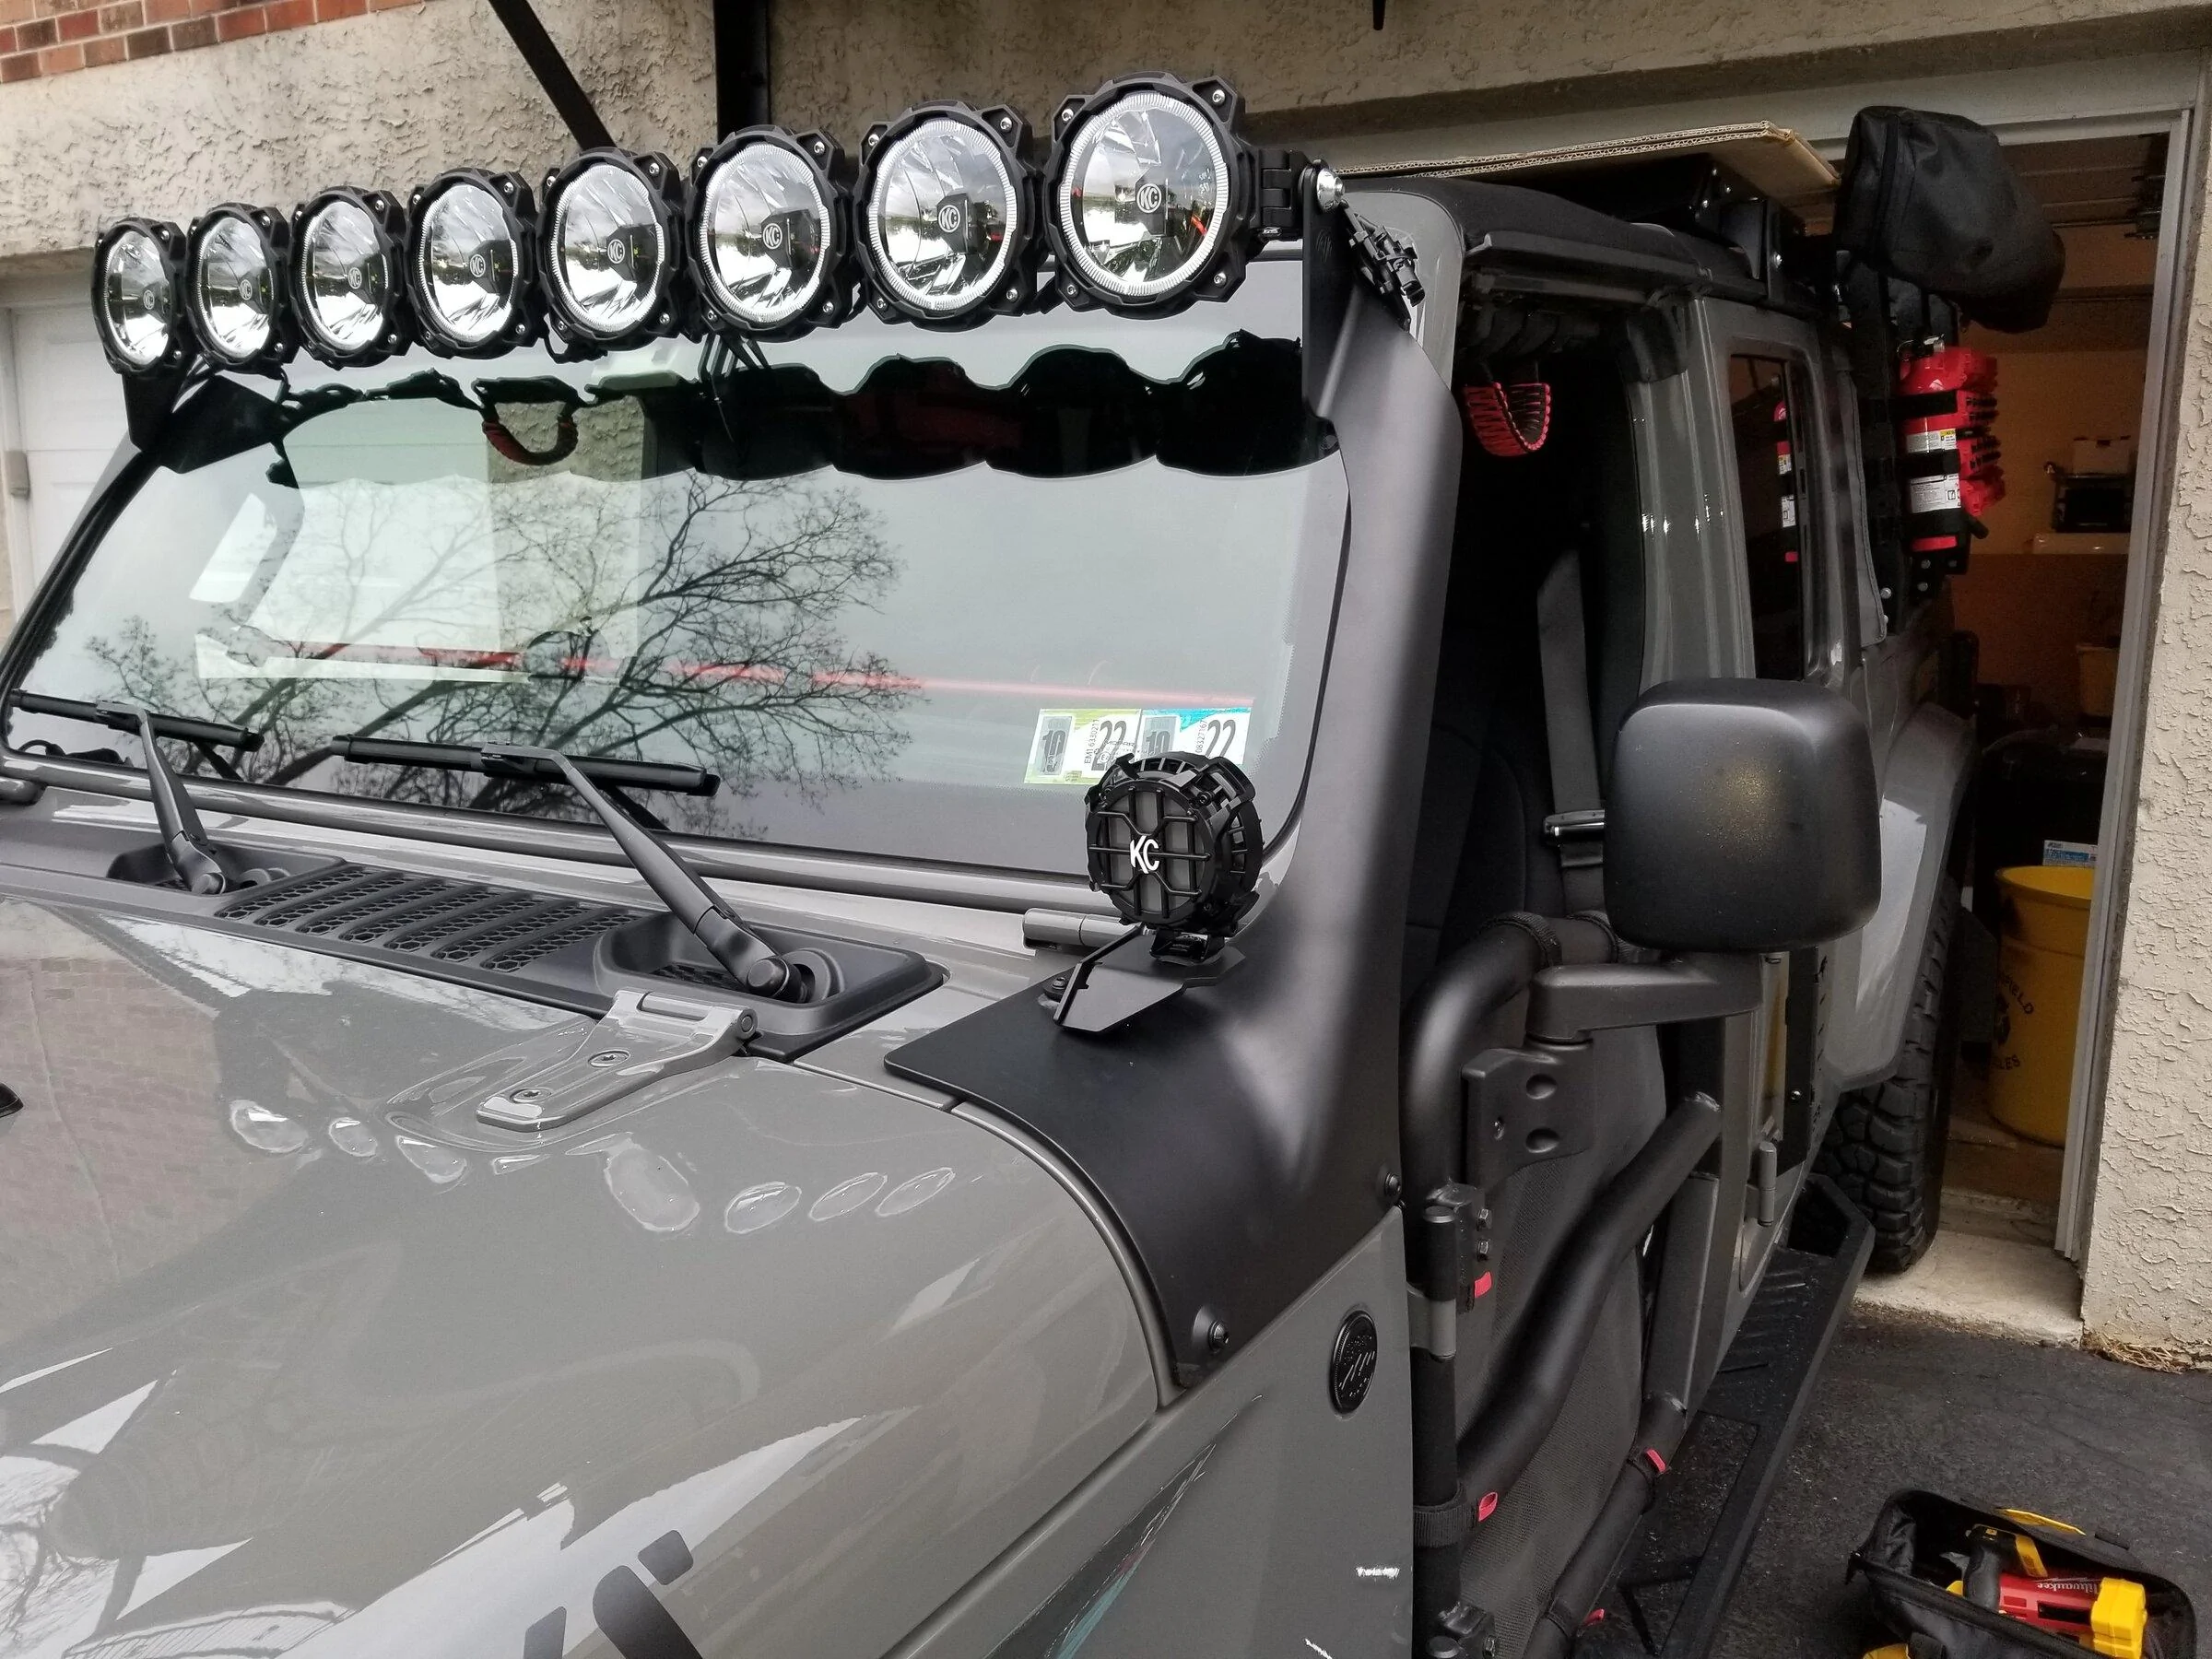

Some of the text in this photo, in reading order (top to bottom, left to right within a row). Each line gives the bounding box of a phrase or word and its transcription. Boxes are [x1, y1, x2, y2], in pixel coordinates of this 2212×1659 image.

[1091, 720, 1127, 771] 22
[1206, 720, 1236, 758] 22
[1130, 835, 1160, 875] KC
